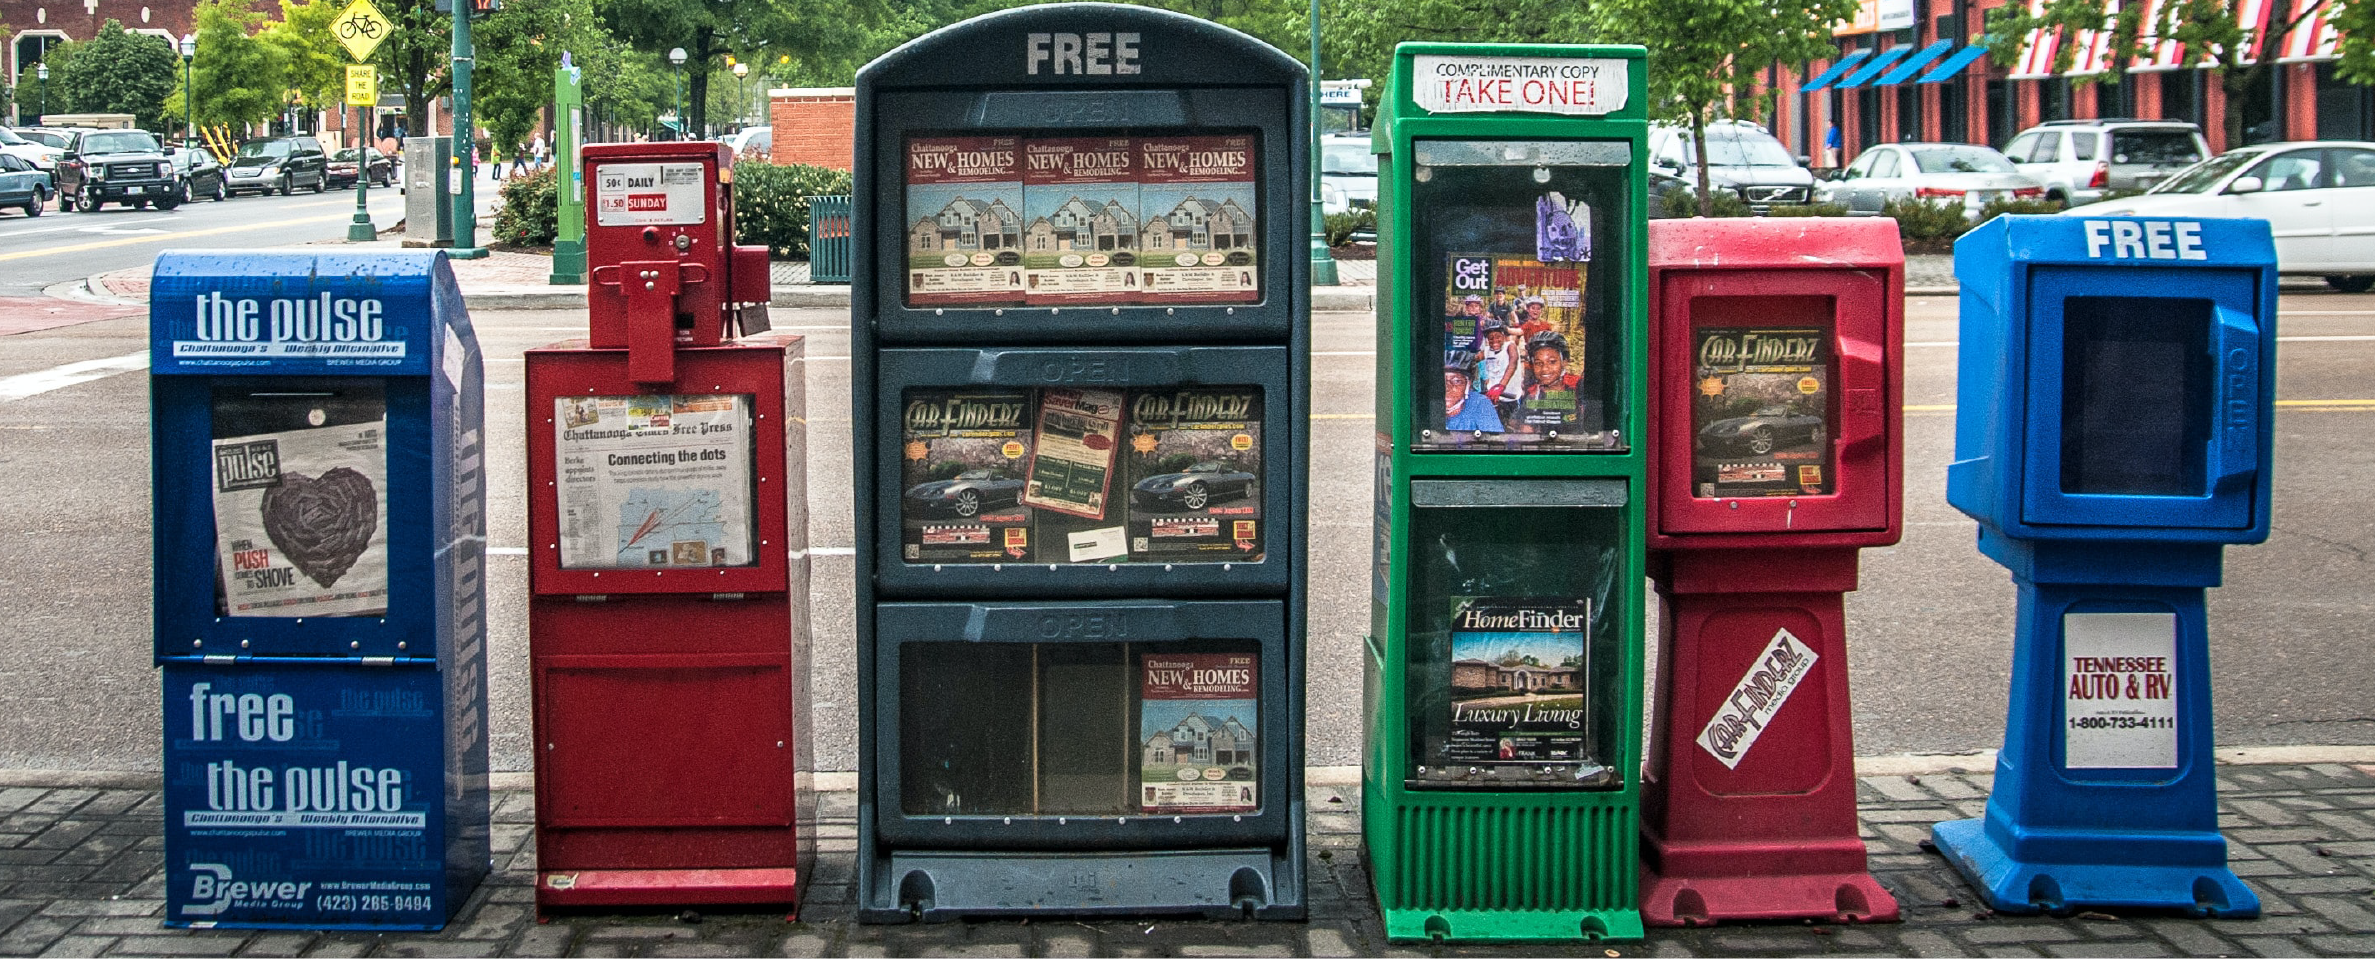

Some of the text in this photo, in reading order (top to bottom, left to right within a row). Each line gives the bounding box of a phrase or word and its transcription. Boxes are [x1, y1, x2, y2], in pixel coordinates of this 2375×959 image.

[1028, 33, 1141, 75] FREE
[350, 70, 371, 78] SHARE
[1436, 63, 1599, 79] COMPLIMENTARY COPY
[355, 81, 367, 90] THE
[1443, 79, 1595, 106] TAKE ONE!
[352, 92, 370, 101] ROAD
[911, 151, 1014, 173] NEW & HOMES
[1027, 152, 1130, 174] NEW & HOMES
[1144, 151, 1246, 173] NEW & HOMES
[628, 177, 654, 188] DAILY
[628, 198, 667, 208] SUNDAY
[2084, 220, 2208, 260] FREE
[1455, 259, 1489, 275] Get
[1455, 274, 1489, 290] Out
[197, 291, 382, 342] the pulse
[284, 344, 331, 353] Weekly
[333, 344, 399, 353] Alternative
[672, 423, 698, 435] Free
[700, 421, 733, 435] Press
[608, 448, 726, 466] Connecting the dots
[220, 445, 277, 488] pulse
[233, 549, 270, 570] PUSH
[254, 567, 295, 588] SHOVE
[1463, 610, 1583, 628] HomeFinder
[2073, 657, 2166, 673] TENNESSEE
[1148, 669, 1249, 690] NEW & HOMES
[1764, 658, 1809, 715] media group
[2069, 674, 2172, 700] AUTO & RV
[190, 682, 293, 741] free
[1452, 703, 1583, 729] Luxury Living
[2069, 717, 2173, 729] 1-800-733-4111
[208, 760, 273, 811] the
[286, 760, 401, 812] pulse
[301, 814, 347, 824] Weekly
[350, 814, 419, 823] Alternative
[234, 900, 303, 910] Media Group
[317, 895, 357, 912] (423)
